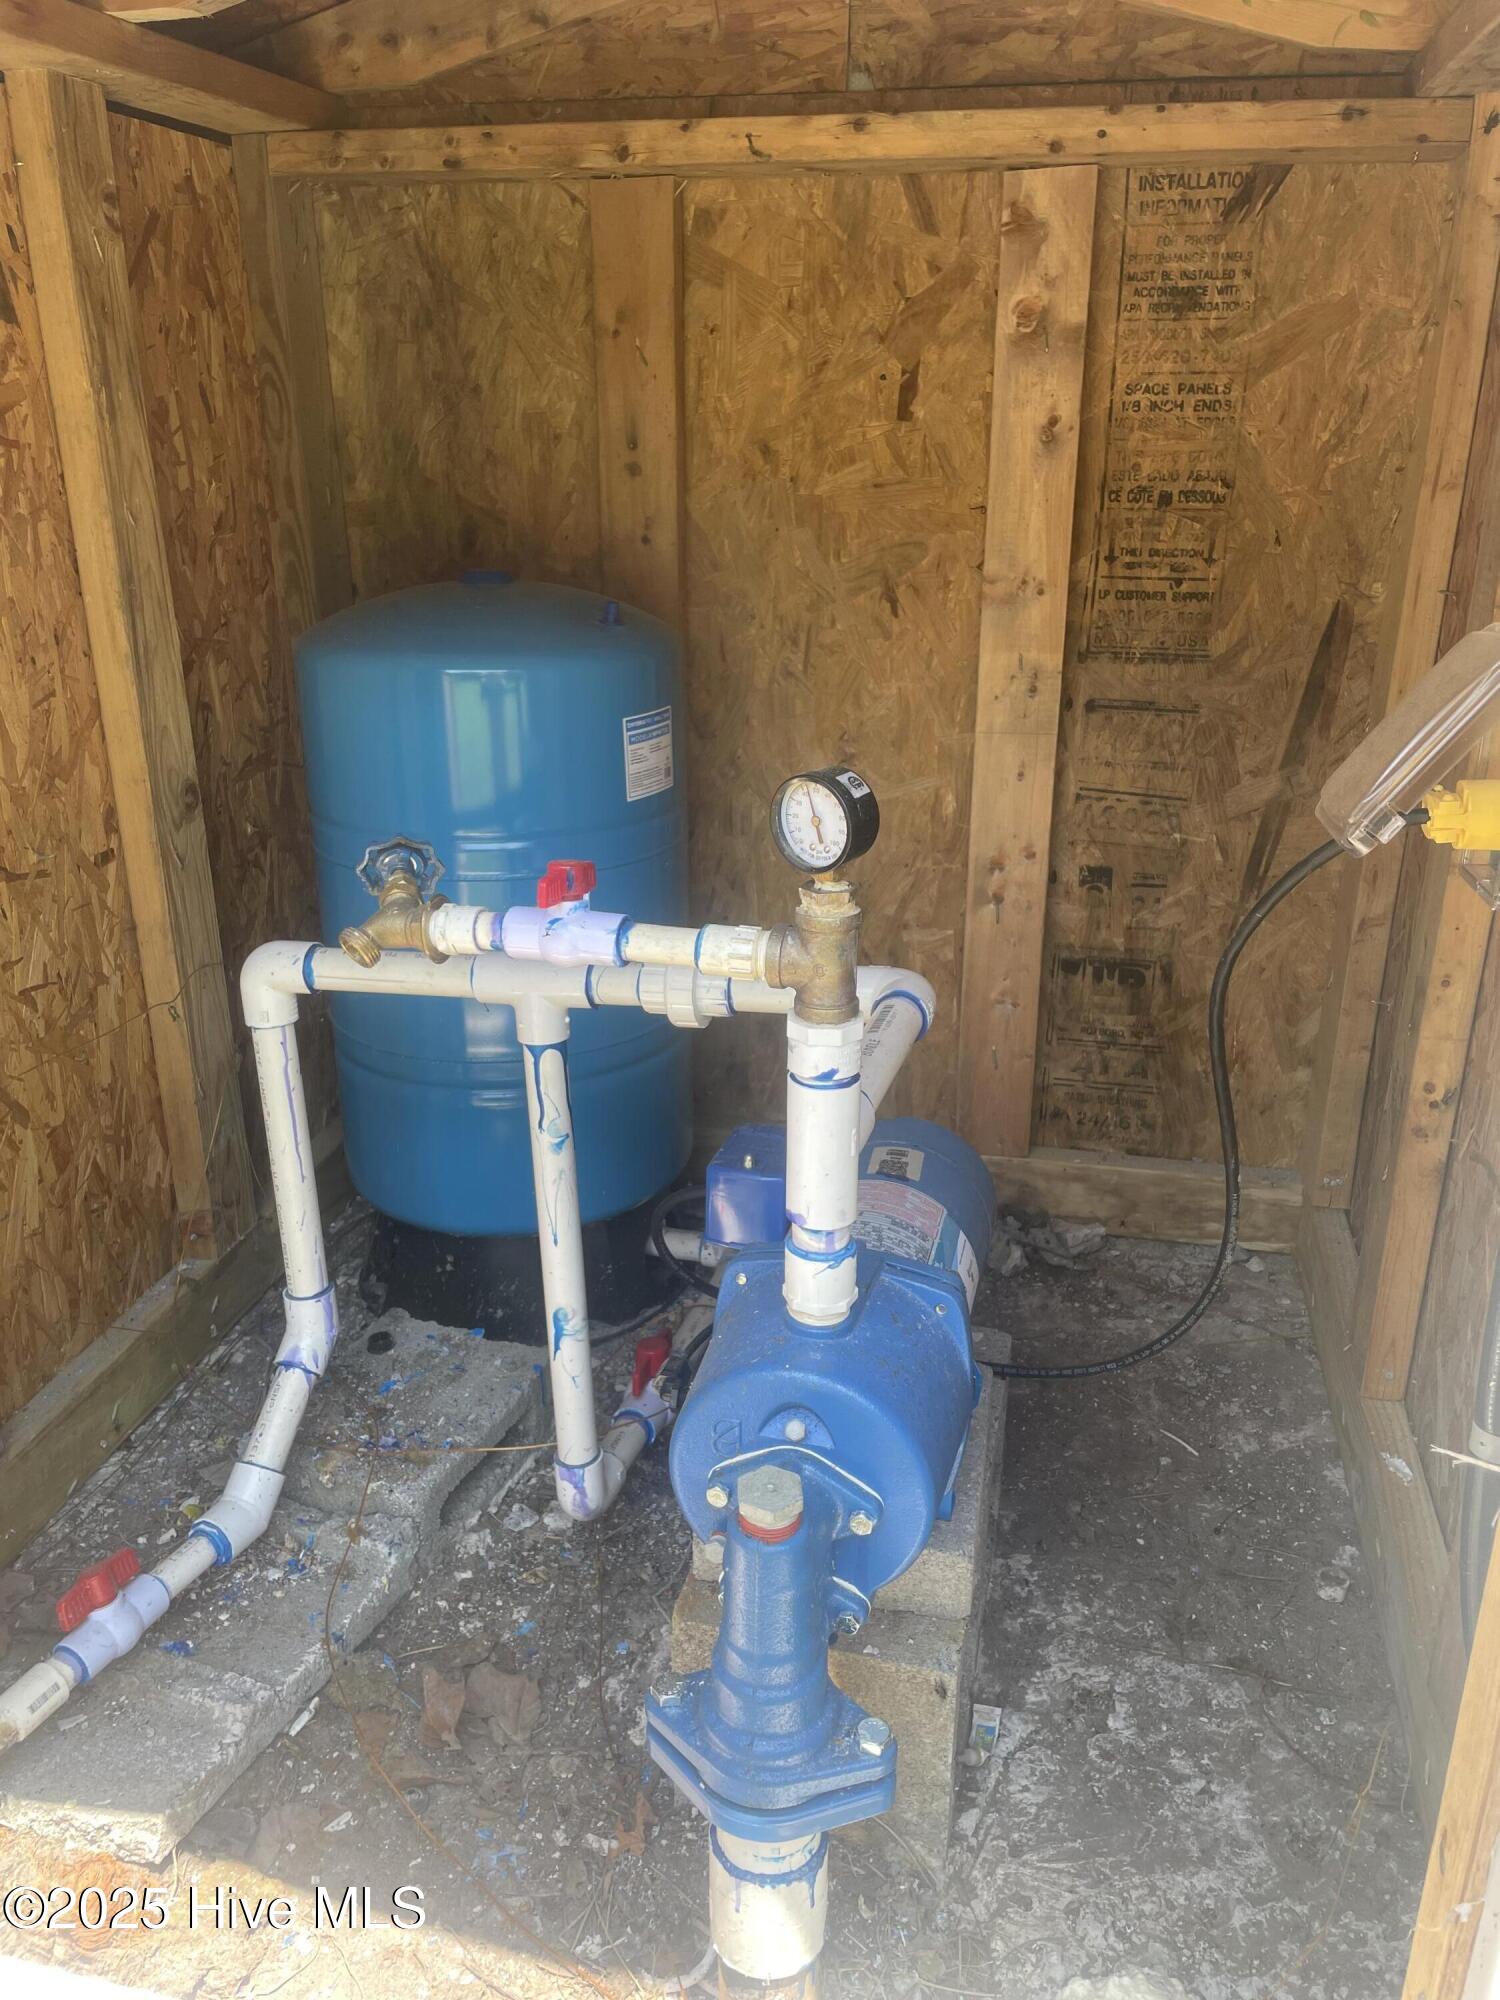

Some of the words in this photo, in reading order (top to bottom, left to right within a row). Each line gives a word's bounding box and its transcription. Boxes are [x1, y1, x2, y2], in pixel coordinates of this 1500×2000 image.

[1138, 171, 1257, 192] INSTALLATION
[1138, 195, 1249, 216] INFORMATI
[1125, 270, 1156, 282] MUST
[1179, 269, 1236, 281] INSTALLED
[1147, 300, 1251, 315] RECOMENDATIONS
[1124, 382, 1171, 396] SPACE
[1178, 382, 1233, 396] PANELS
[1150, 399, 1185, 413] INCH
[1111, 470, 1140, 483] ESTE
[1098, 589, 1111, 600] LP
[1114, 589, 1167, 601] CUSTOMER
